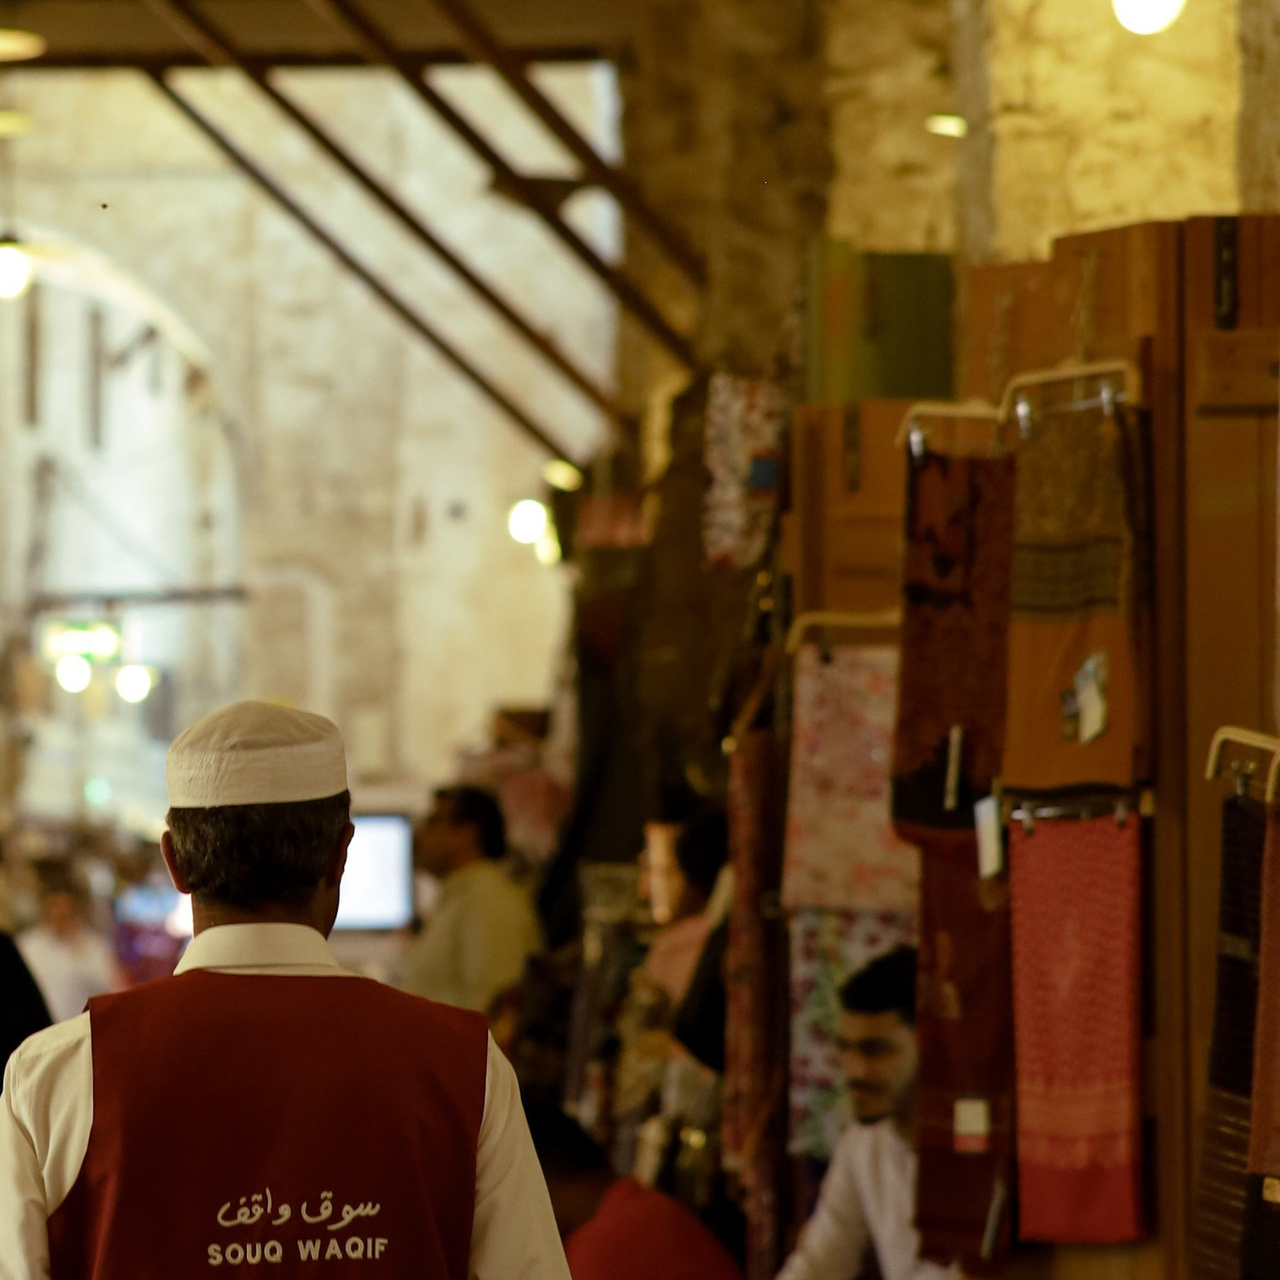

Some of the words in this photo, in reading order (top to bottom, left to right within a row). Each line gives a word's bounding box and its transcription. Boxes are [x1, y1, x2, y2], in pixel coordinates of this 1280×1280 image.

[216, 1186, 292, 1228] واقف
[300, 1190, 381, 1231] سوق
[207, 1239, 283, 1266] SOUQ
[296, 1235, 389, 1262] WAQIF
